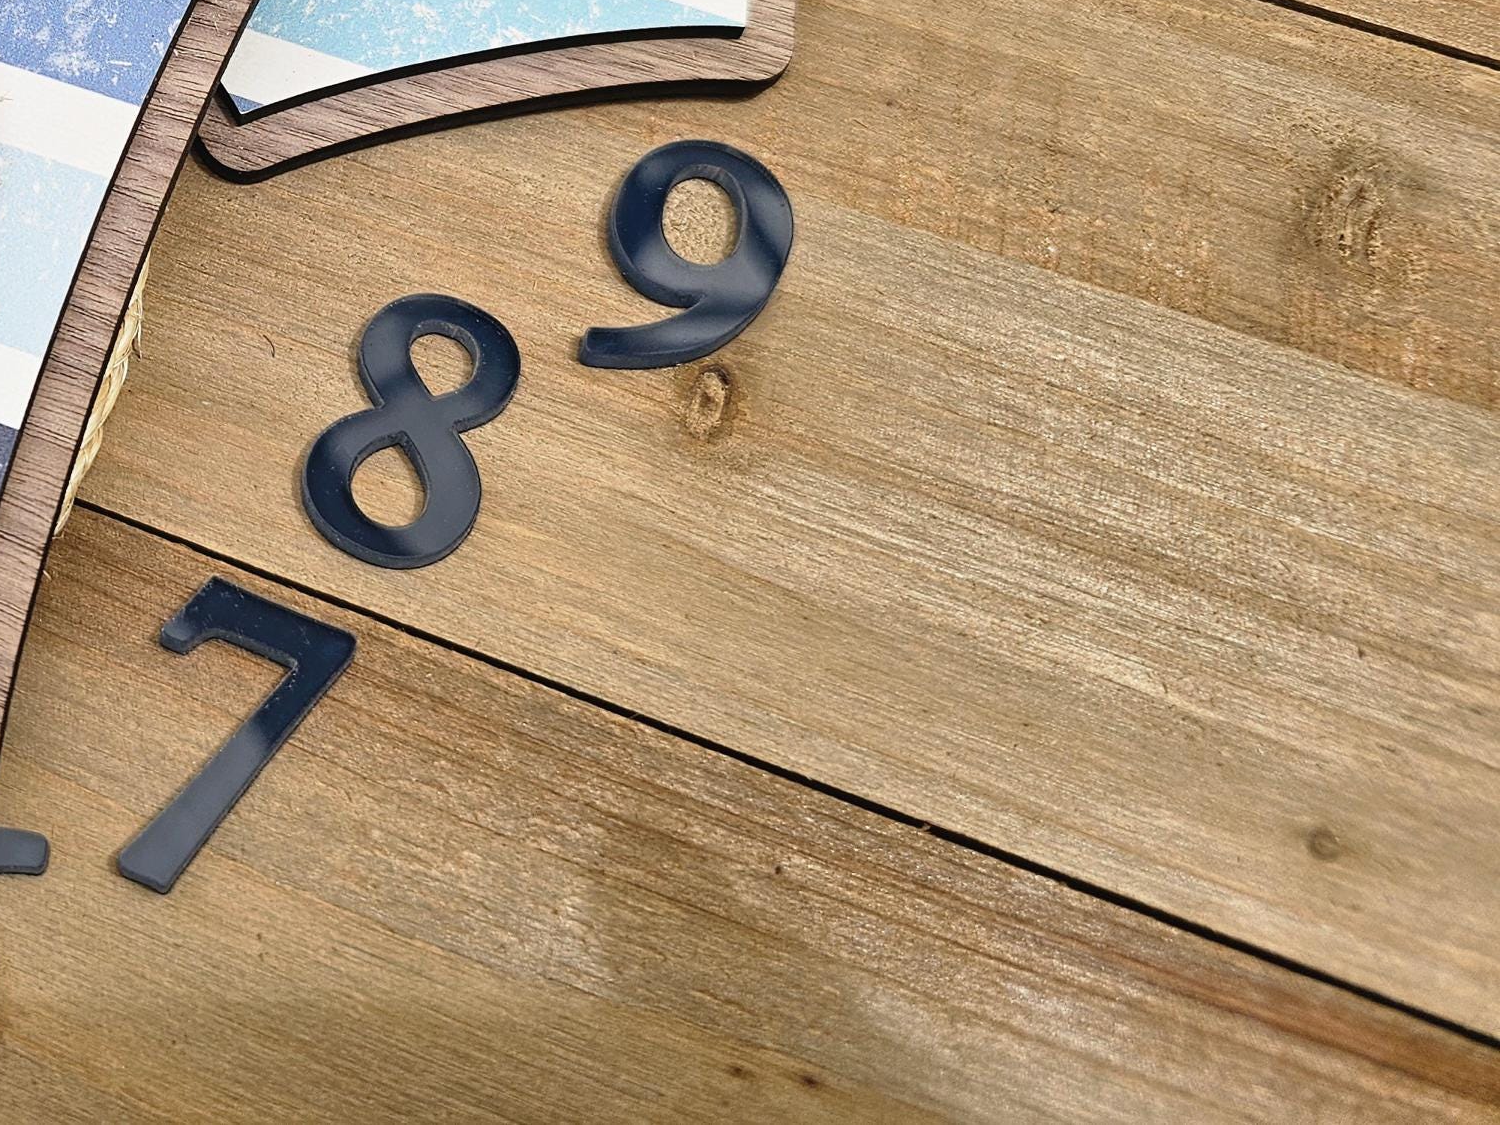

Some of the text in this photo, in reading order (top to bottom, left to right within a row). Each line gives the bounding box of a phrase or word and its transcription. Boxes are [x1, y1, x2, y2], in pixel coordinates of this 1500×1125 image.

[578, 139, 793, 369] 9
[301, 293, 520, 570] 8
[117, 575, 357, 894] 7
